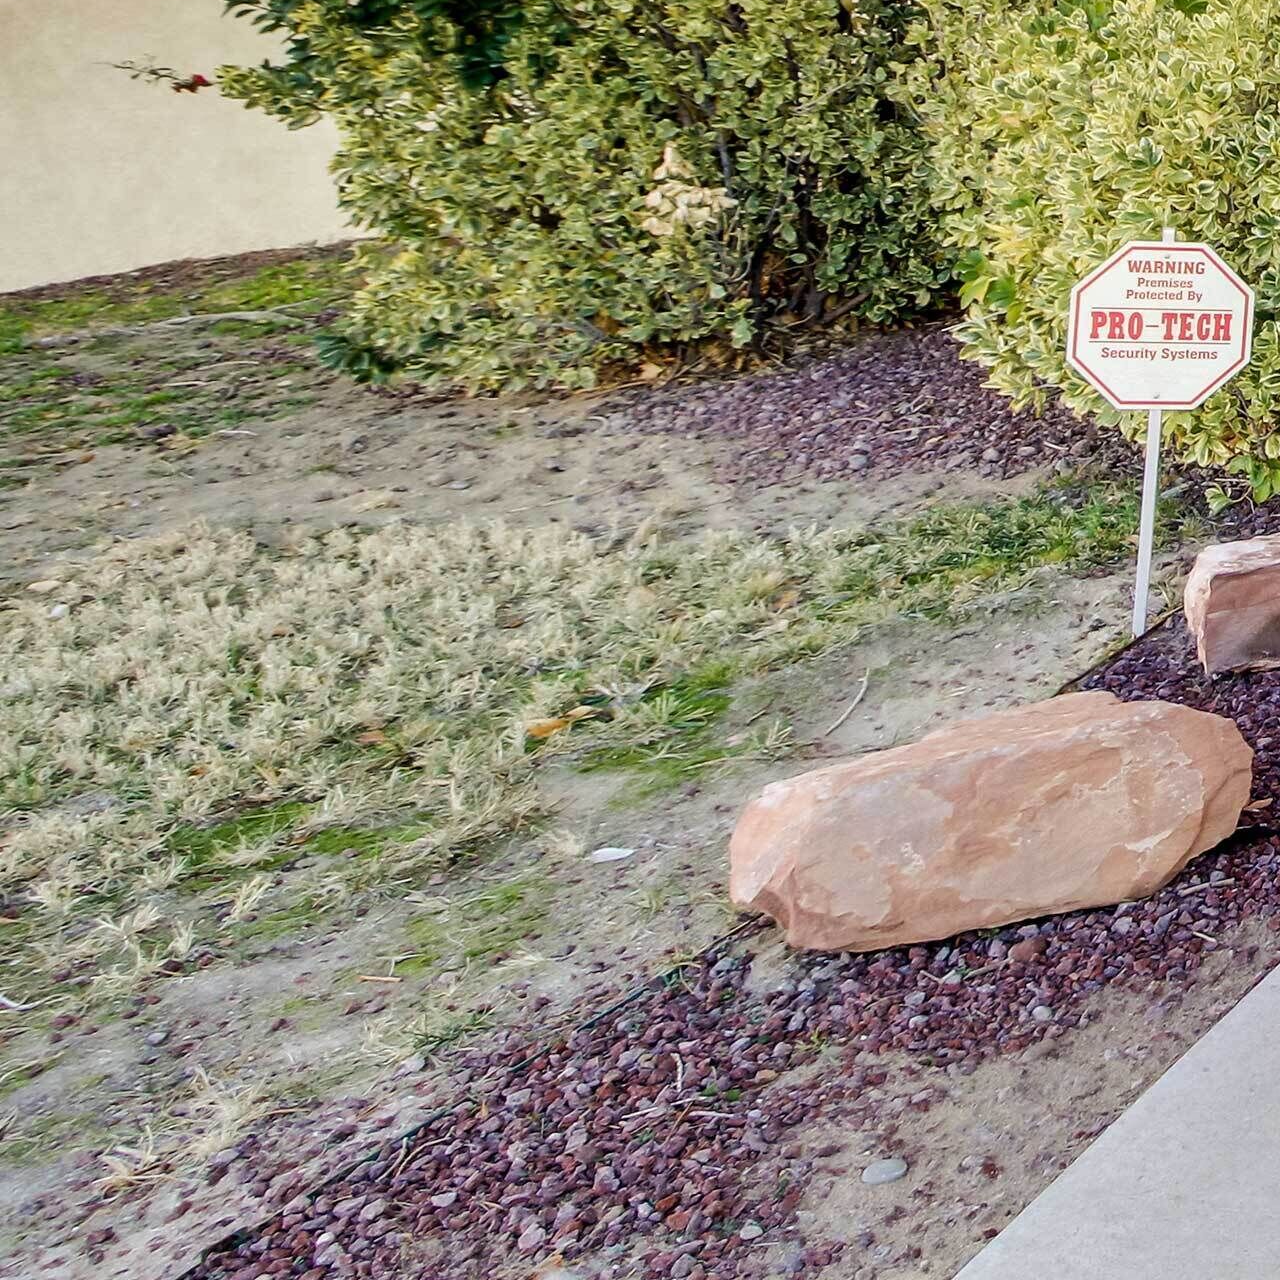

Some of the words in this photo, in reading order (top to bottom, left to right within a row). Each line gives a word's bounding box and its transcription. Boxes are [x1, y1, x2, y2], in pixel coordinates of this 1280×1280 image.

[1127, 260, 1206, 275] WARNING
[1137, 277, 1194, 289] Premises
[1126, 289, 1183, 301] Protected
[1187, 290, 1203, 303] By
[1089, 311, 1233, 341] PRO-TECH
[1101, 347, 1158, 361] Security
[1161, 348, 1218, 361] Systems
